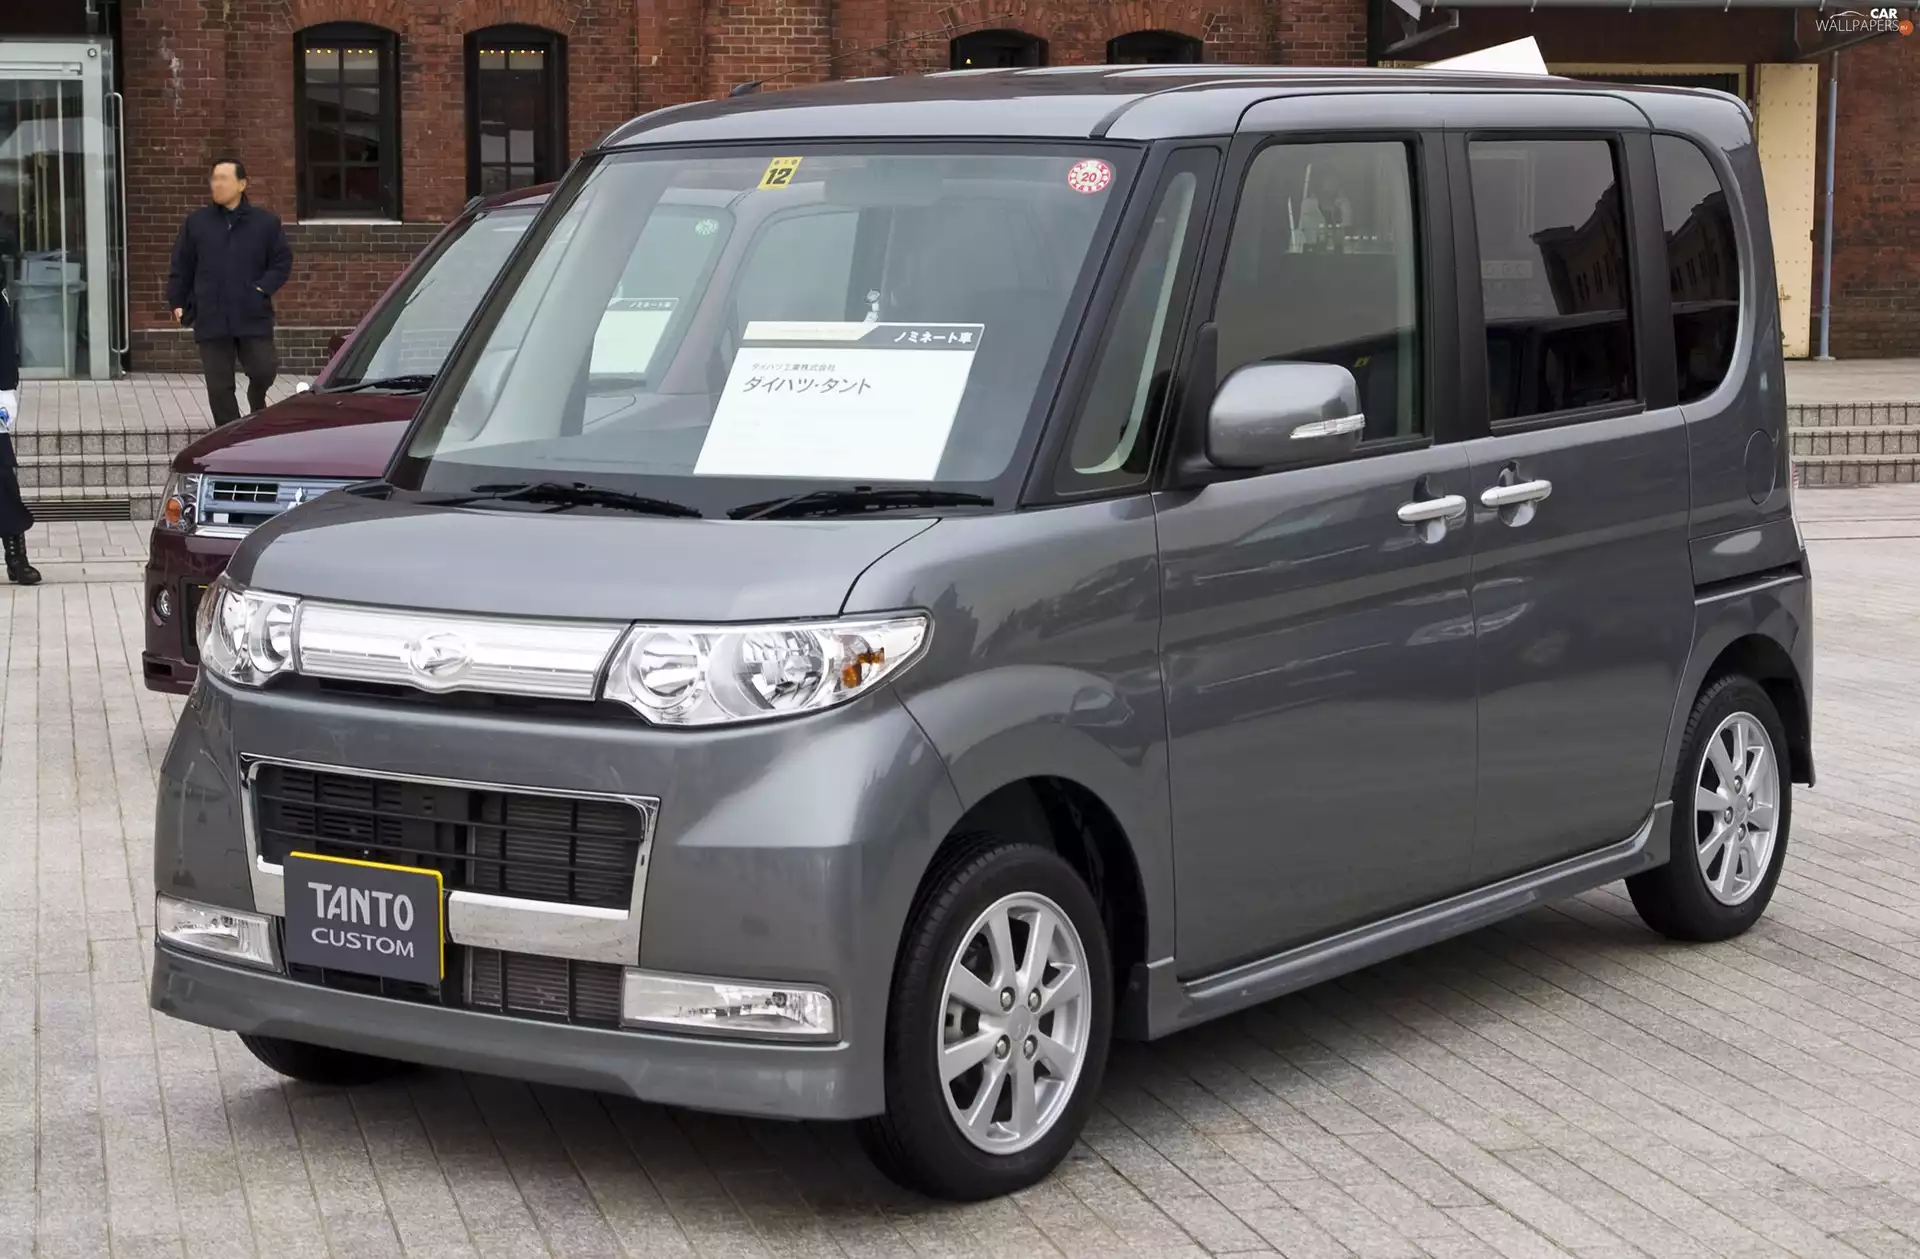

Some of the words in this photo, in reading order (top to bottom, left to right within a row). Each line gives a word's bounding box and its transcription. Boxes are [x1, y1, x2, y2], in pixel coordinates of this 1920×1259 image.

[766, 167, 792, 185] 12
[1081, 172, 1097, 183] 20
[894, 331, 973, 344] ノミネート車
[308, 882, 414, 931] TANTO
[311, 927, 415, 958] CUSTOM
